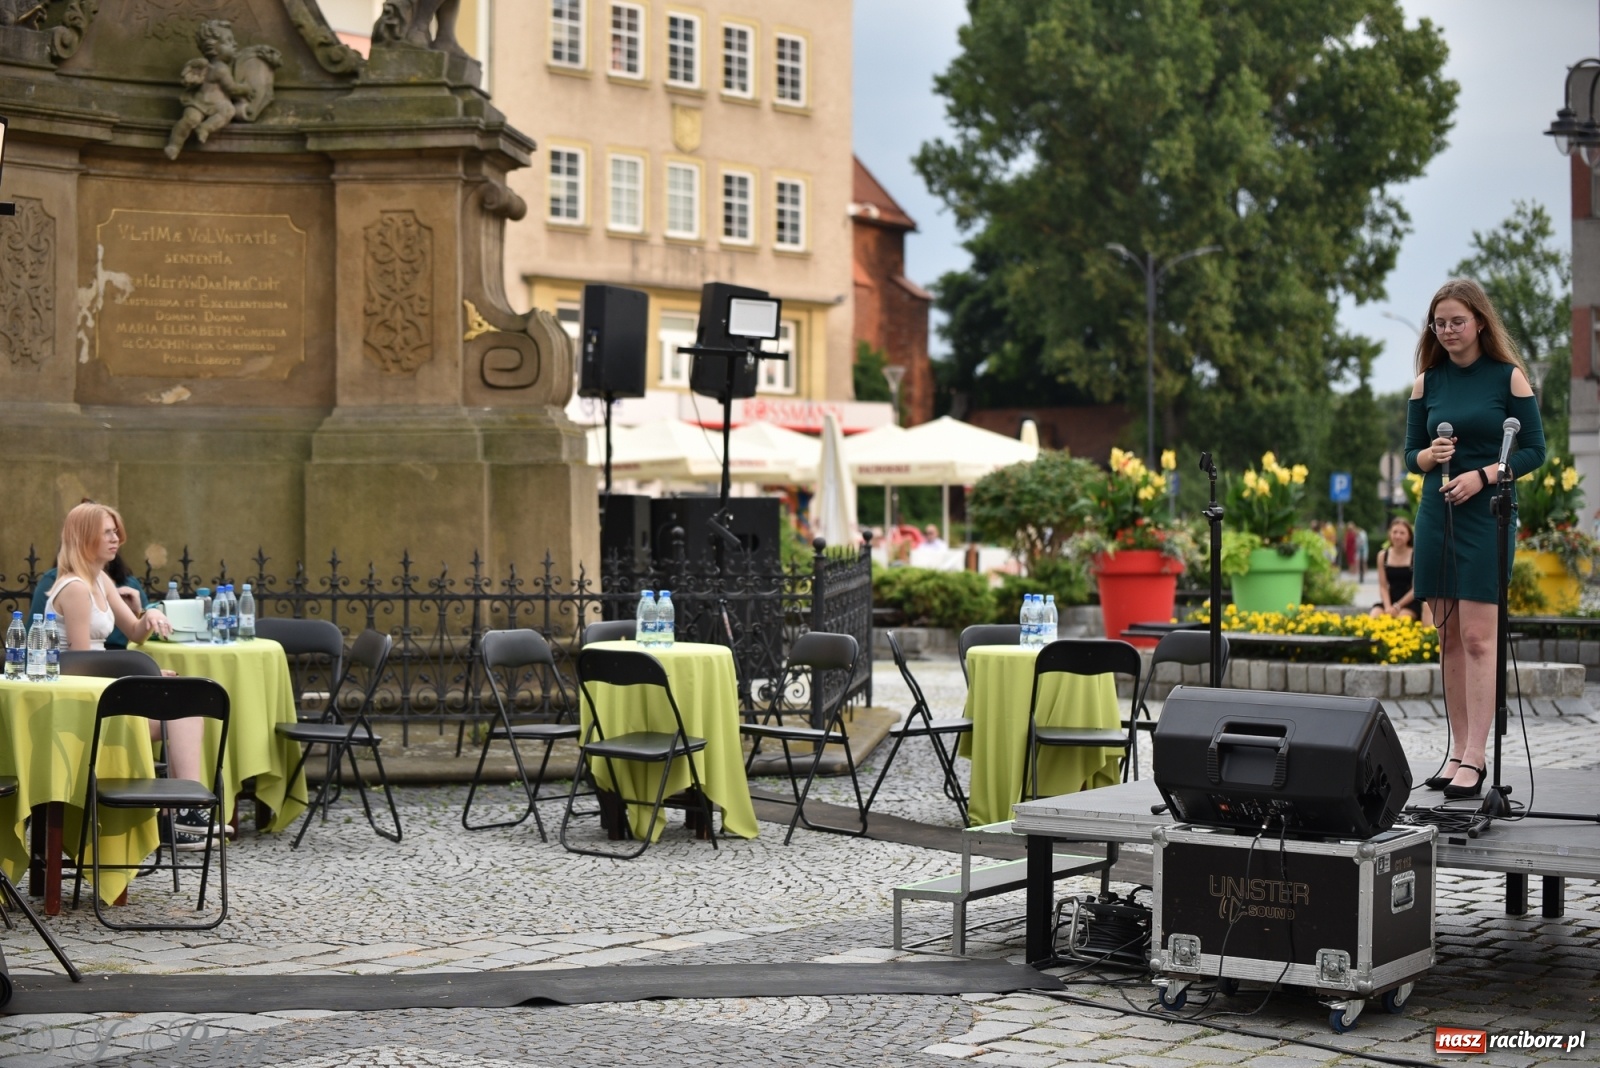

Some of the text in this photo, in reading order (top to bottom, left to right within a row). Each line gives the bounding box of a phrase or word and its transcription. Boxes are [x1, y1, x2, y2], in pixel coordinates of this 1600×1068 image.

[163, 250, 233, 265] SENTENTIA
[115, 322, 158, 335] MARIA
[163, 324, 232, 337] ELISABETH
[1334, 474, 1348, 495] P
[1209, 874, 1310, 905] UNISTER
[1248, 904, 1296, 920] SOUND
